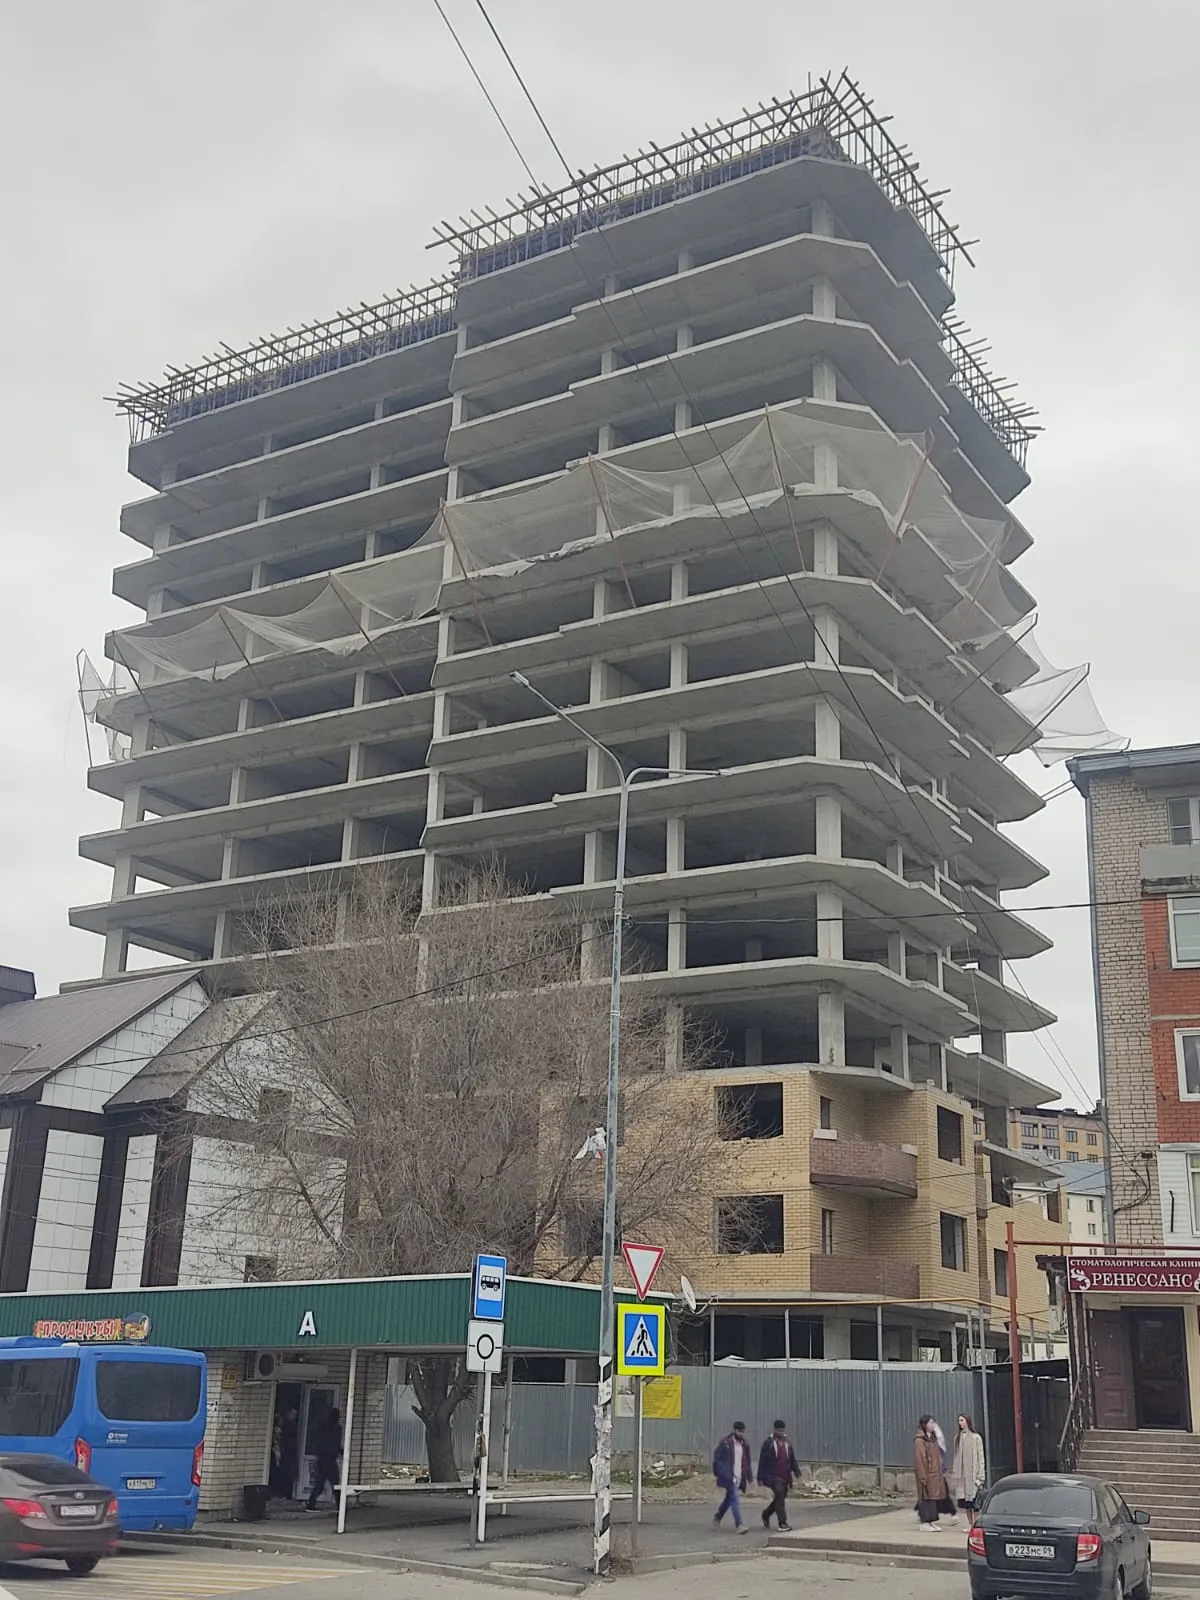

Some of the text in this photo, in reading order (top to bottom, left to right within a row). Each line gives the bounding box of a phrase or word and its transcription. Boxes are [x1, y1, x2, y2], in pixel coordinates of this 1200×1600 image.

[1070, 1259, 1167, 1267] СТОМАТОЛОГИЧЕСКАЯ
[1091, 1272, 1192, 1287] РЕНЕССАНС
[42, 1320, 115, 1338] ПРОДУКТЫ
[298, 1311, 317, 1336] А
